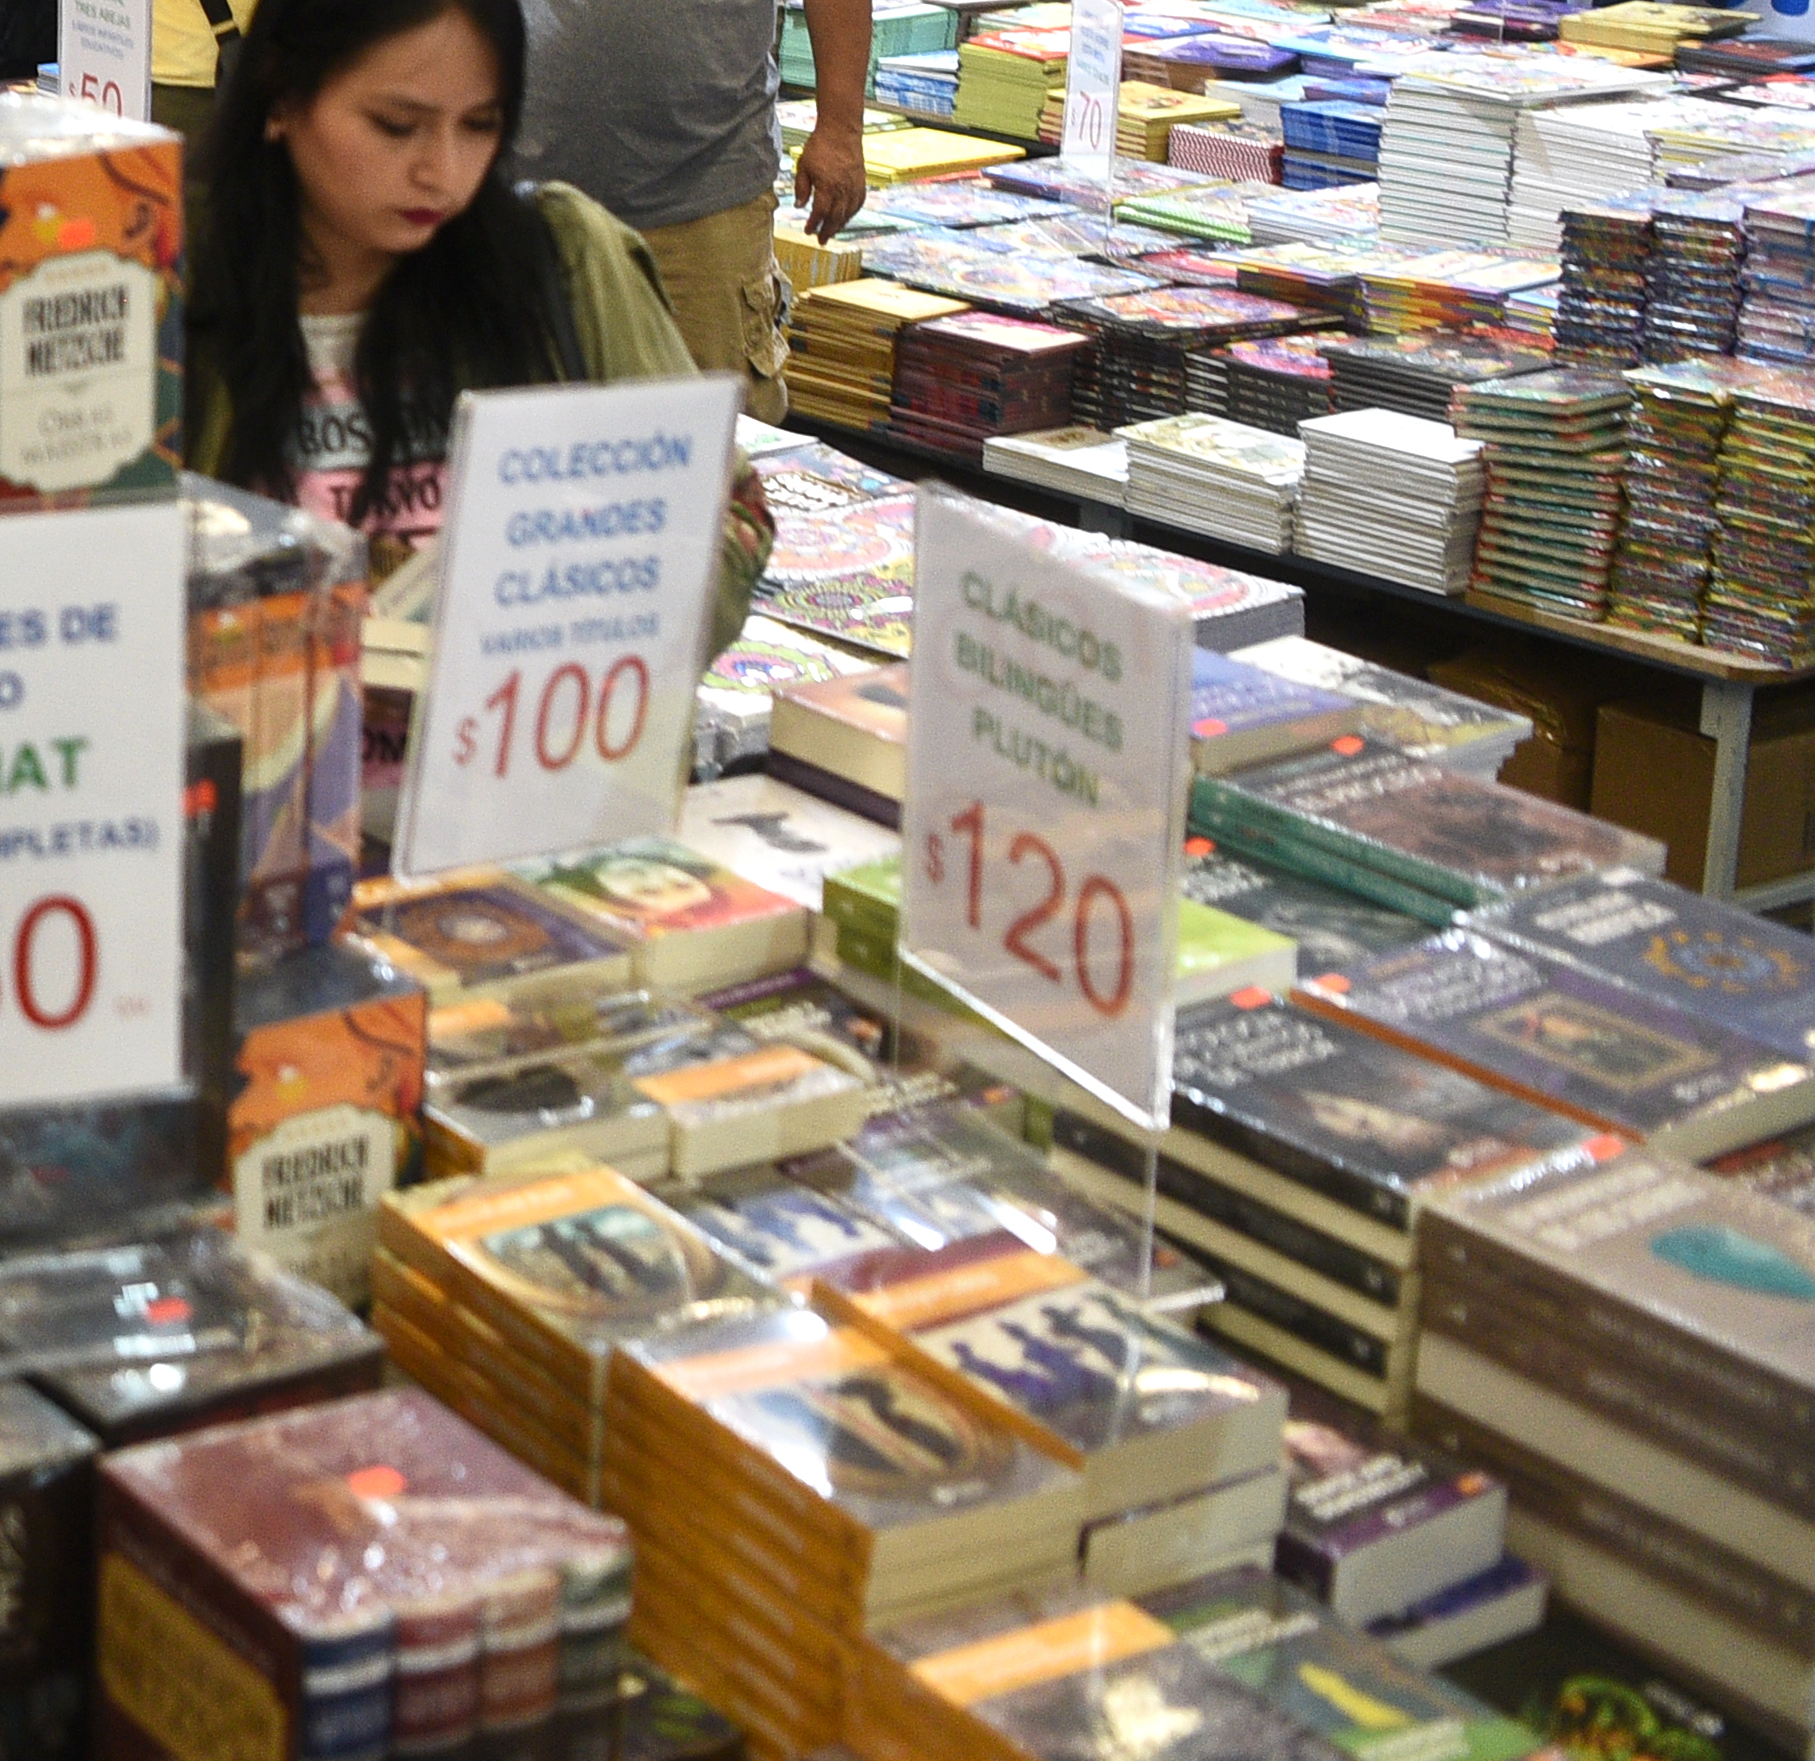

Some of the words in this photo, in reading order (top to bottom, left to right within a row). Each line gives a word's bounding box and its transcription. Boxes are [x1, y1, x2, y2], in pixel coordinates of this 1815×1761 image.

[22, 284, 130, 335] FRIEDRICH
[499, 430, 691, 484] COLECCIÓN
[506, 499, 668, 547] GRANDES
[494, 554, 661, 608] CLÁSICOS
[61, 604, 118, 643] DE
[480, 626, 565, 657] VARIOS
[962, 569, 1124, 682] CLÁSICOS
[956, 632, 1125, 753] BILINGÜES
[974, 706, 1101, 807] PLUTÓN
[259, 1132, 370, 1190] FRIEDRICH
